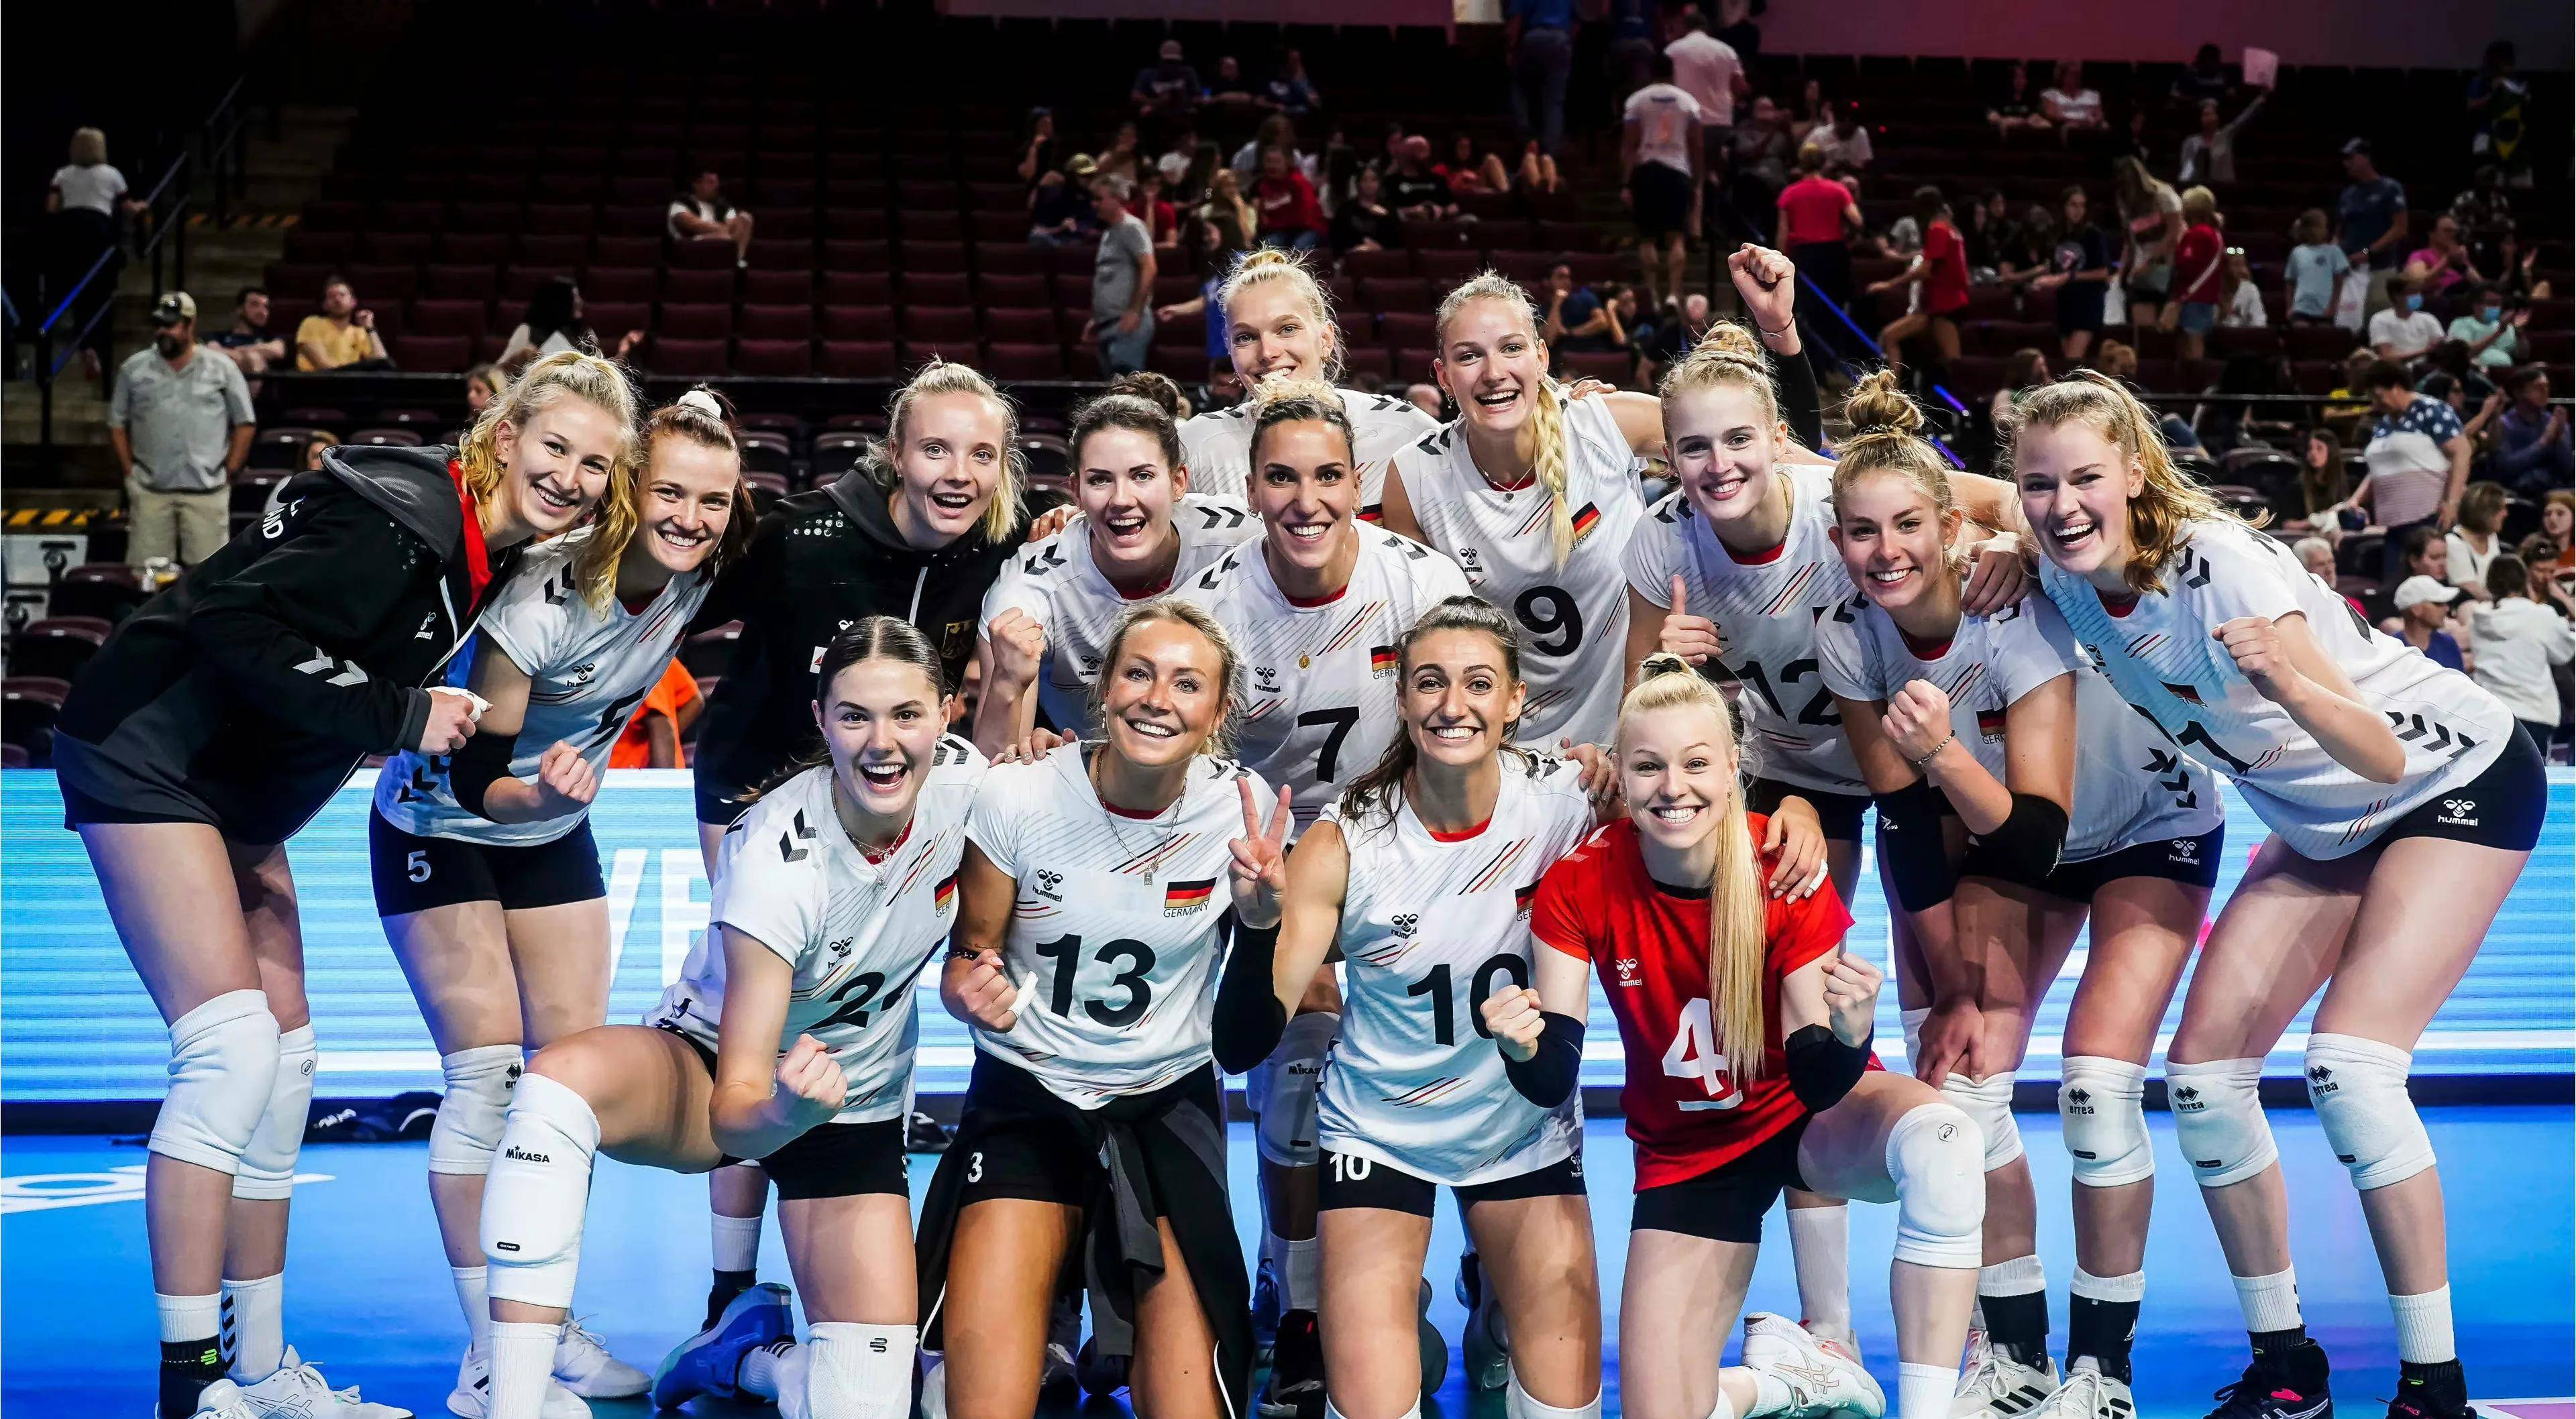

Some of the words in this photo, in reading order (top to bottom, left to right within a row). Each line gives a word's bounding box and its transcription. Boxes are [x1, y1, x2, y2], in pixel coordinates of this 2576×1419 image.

[1513, 585, 1583, 657] 9
[1255, 683, 1281, 693] hummel
[1297, 706, 1359, 783] 7
[2437, 815, 2478, 826] hummel
[408, 850, 431, 883] 5
[2169, 854, 2200, 865] hummel
[1032, 885, 1063, 902] hummel
[1163, 901, 1210, 918] GERMANY
[1036, 933, 1157, 1027] 13
[1407, 953, 1529, 1047] 10
[1662, 997, 1729, 1096] 4
[1330, 1153, 1371, 1182] 10
